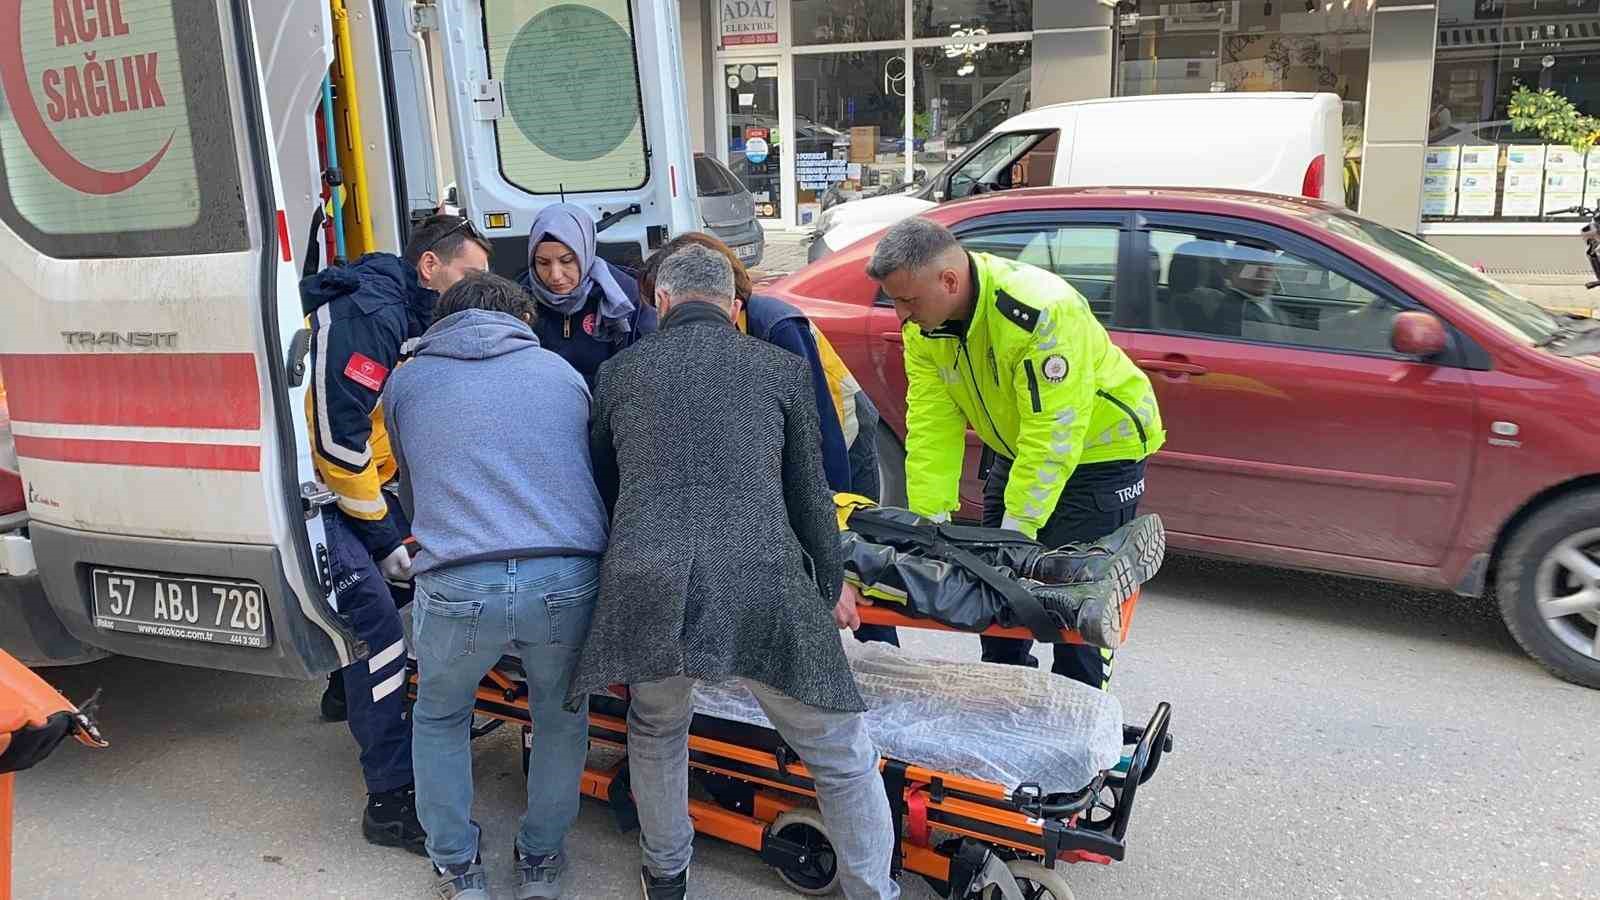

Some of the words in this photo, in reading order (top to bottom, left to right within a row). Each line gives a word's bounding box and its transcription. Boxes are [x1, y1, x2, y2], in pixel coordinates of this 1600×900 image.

[724, 0, 775, 21] ADAL
[43, 50, 165, 122] SAĞLIK
[61, 331, 178, 347] TRANSIT
[108, 577, 135, 616] 57
[154, 582, 199, 624] ABJ
[212, 587, 260, 631] 728
